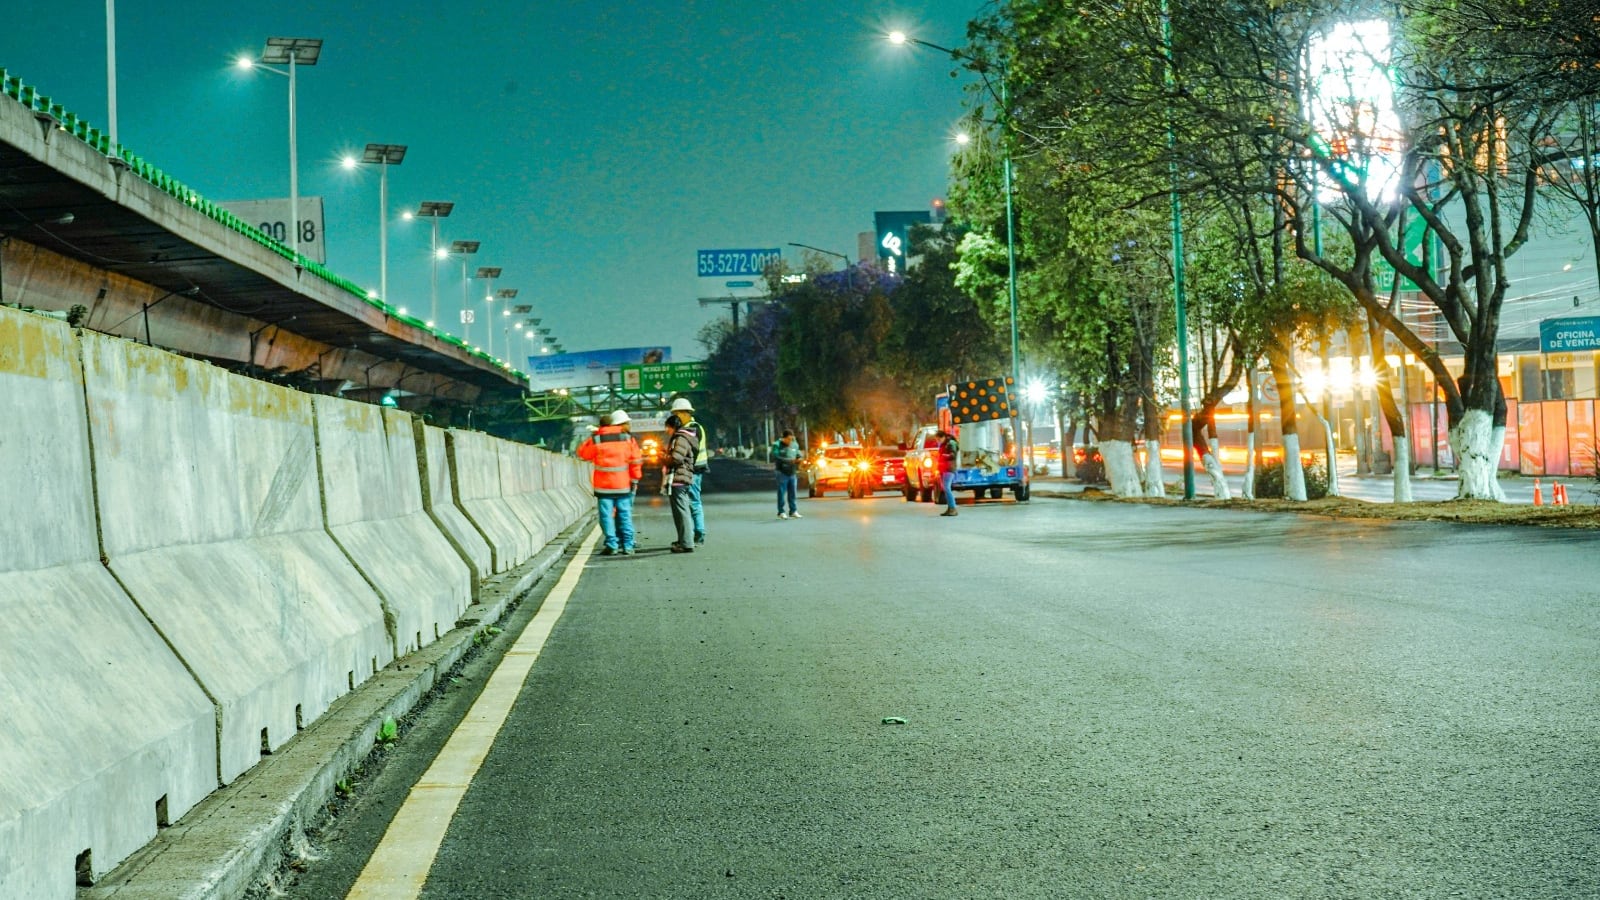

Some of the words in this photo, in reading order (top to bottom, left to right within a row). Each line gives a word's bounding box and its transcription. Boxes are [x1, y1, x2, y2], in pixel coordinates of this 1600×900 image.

[1556, 330, 1595, 342] OFICINA
[1550, 340, 1563, 348] DE
[1565, 338, 1600, 347] VENTAS
